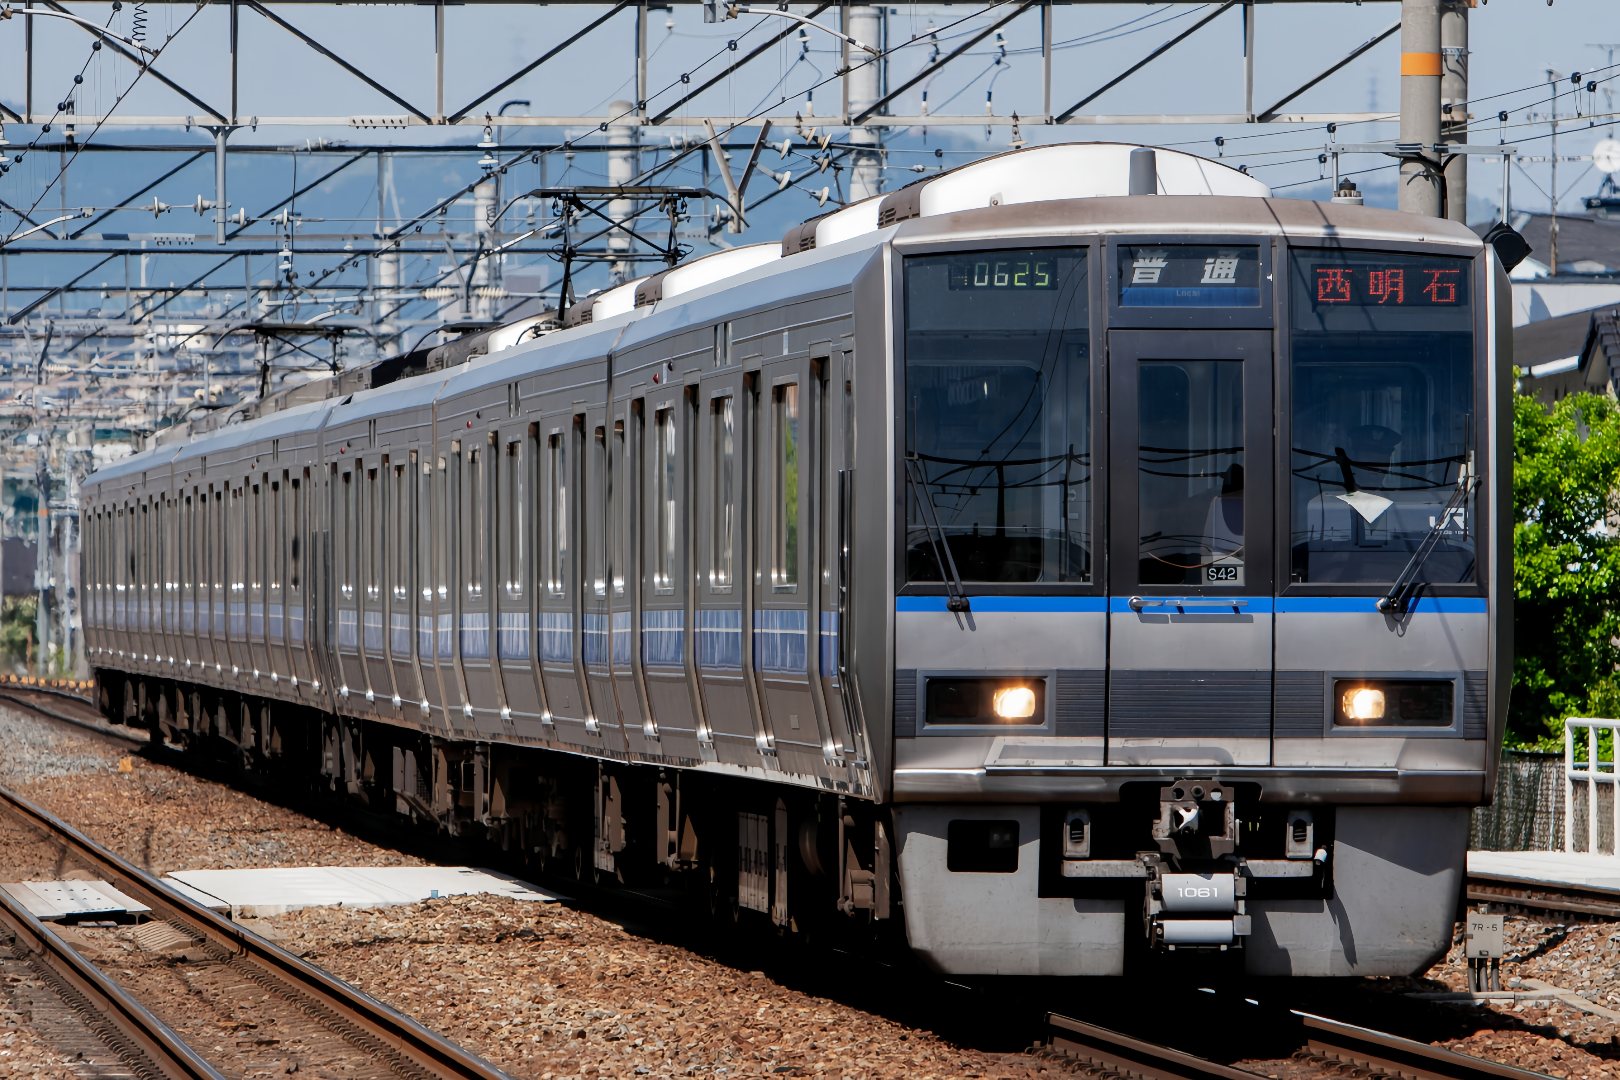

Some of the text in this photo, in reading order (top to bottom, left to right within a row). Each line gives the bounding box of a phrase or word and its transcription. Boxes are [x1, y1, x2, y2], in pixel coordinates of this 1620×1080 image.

[1132, 250, 1240, 284] 普通
[1315, 268, 1460, 303] 西明石
[1208, 567, 1236, 580] S42
[1177, 887, 1218, 898] 1061
